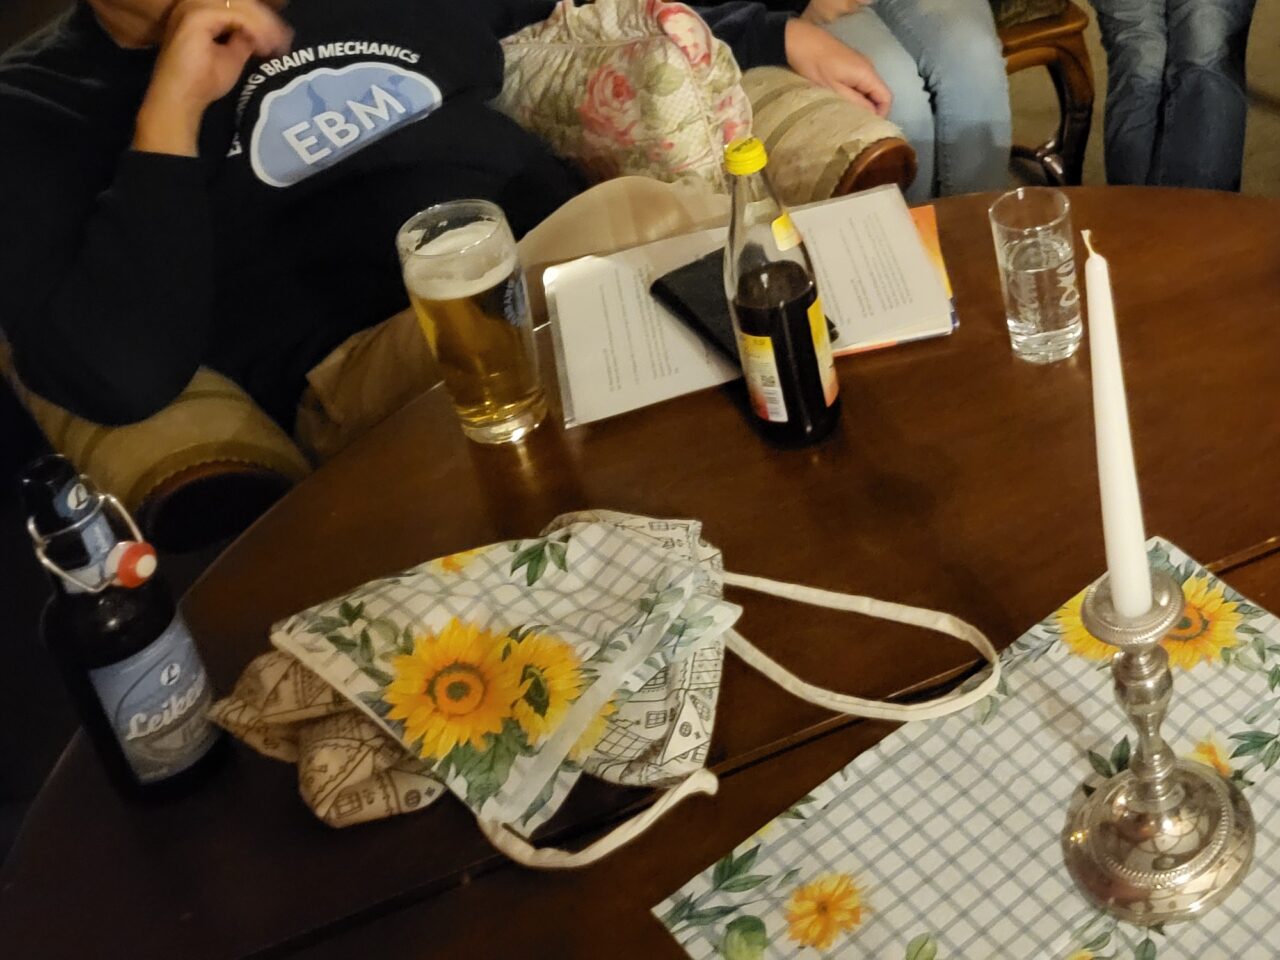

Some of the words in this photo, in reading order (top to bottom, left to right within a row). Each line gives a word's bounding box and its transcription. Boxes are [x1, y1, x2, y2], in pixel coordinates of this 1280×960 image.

[260, 48, 316, 76] BRAIN
[317, 41, 421, 64] MECHANICS
[283, 84, 407, 166] EBM
